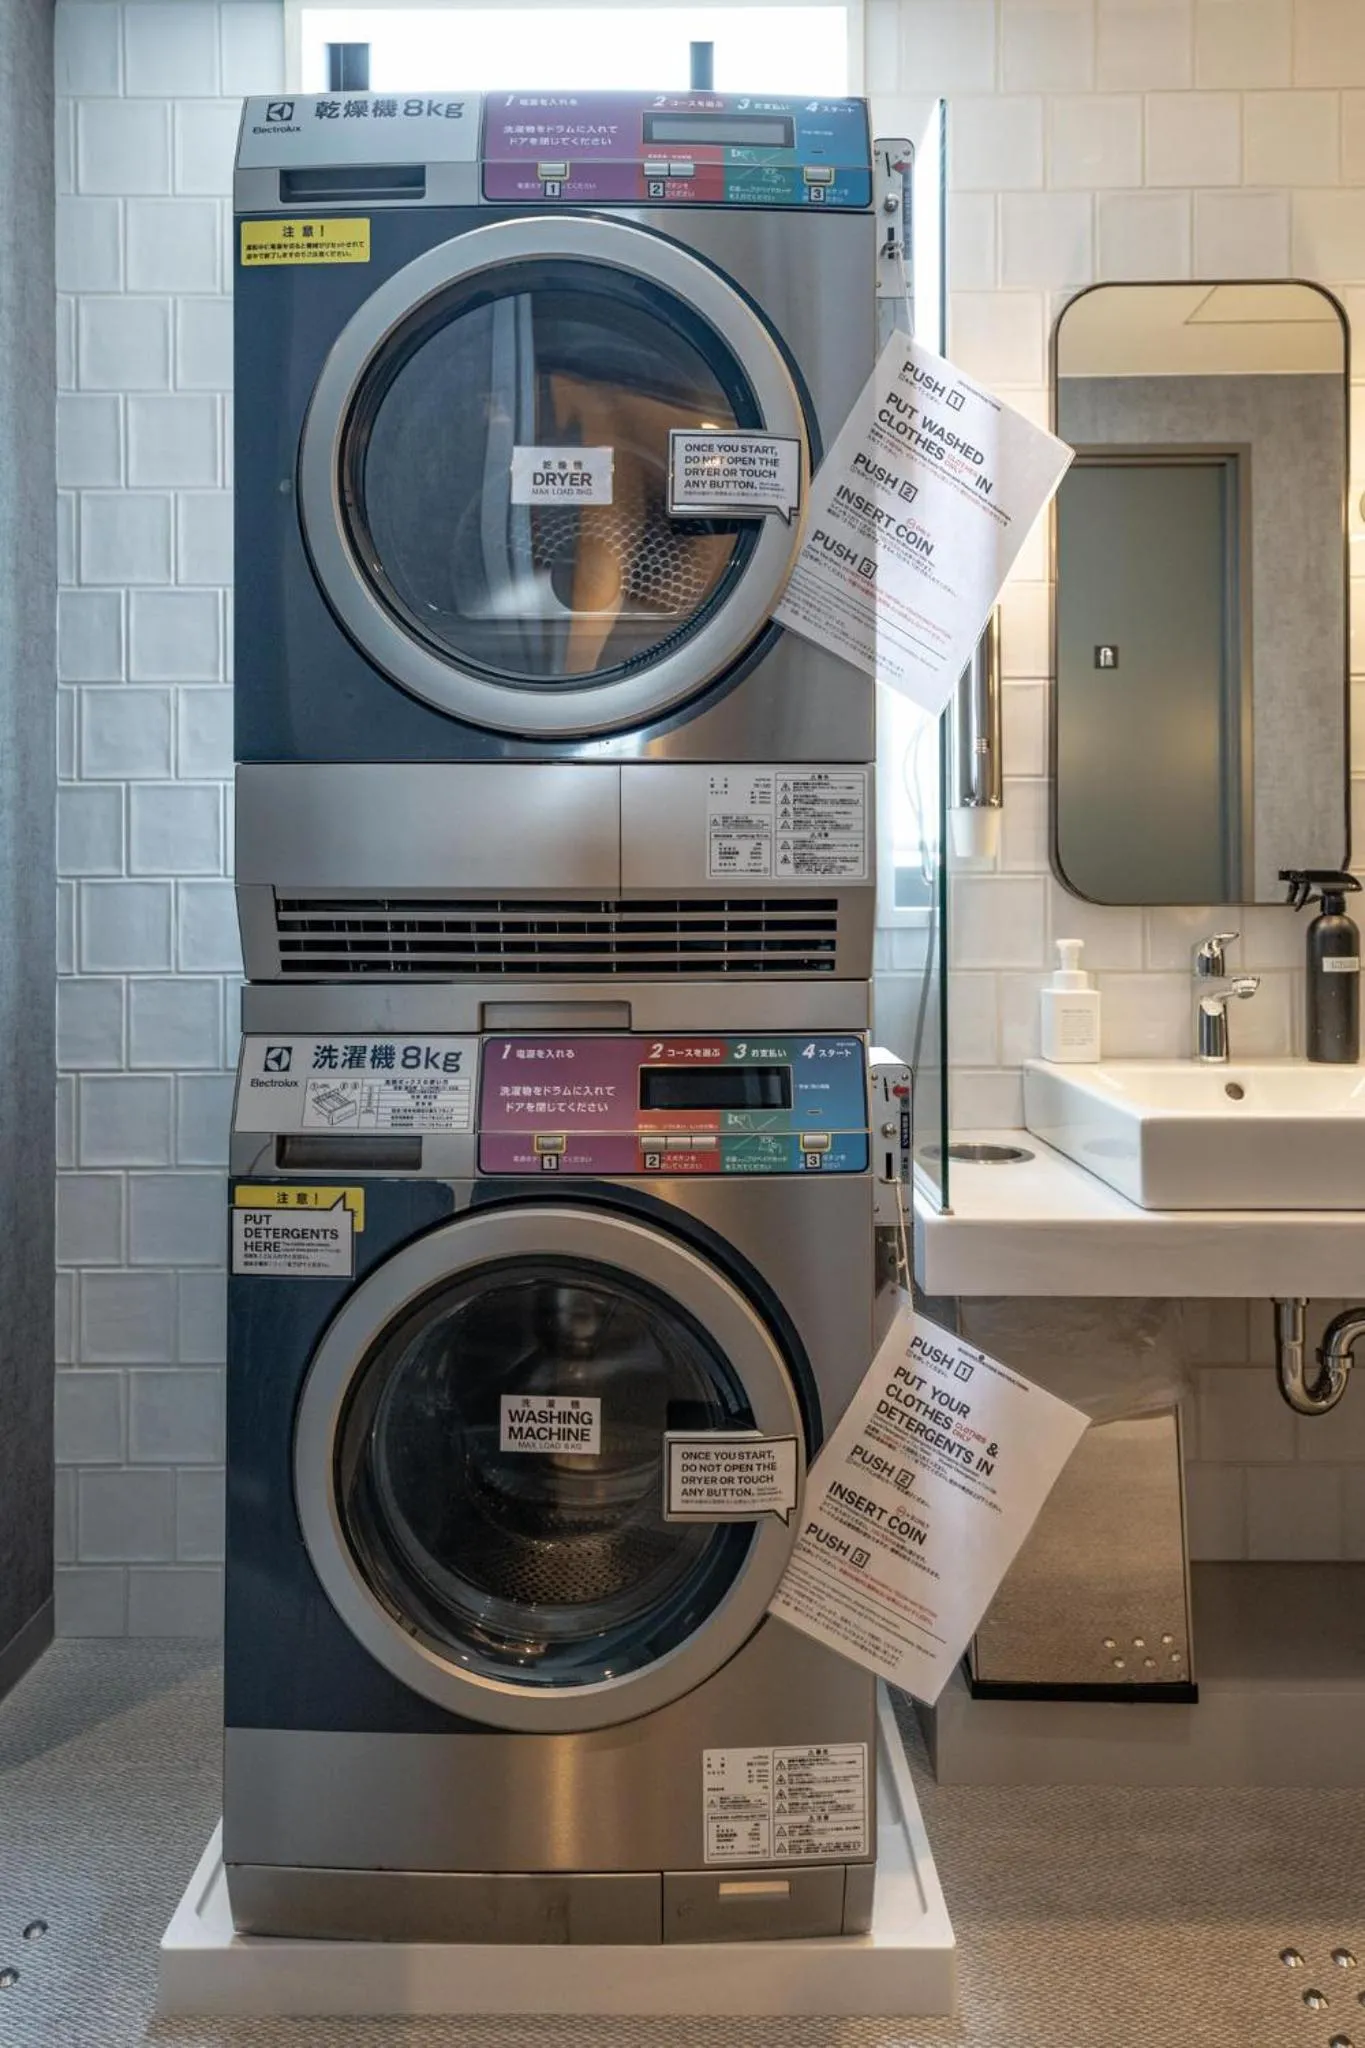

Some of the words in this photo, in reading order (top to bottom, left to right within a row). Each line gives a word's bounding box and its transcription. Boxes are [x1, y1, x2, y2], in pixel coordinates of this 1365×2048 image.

[653, 95, 666, 107] 2
[737, 98, 751, 110] 3
[806, 102, 818, 112] 4
[315, 99, 465, 119] 乾燥機8kg
[252, 125, 301, 134] Electrolux
[902, 361, 946, 398] PUSH
[885, 392, 918, 420] PUT
[921, 415, 985, 466] WASHED
[684, 443, 714, 452] ONCE
[715, 444, 739, 453] YOU
[741, 445, 778, 456] START,
[878, 408, 946, 461] CLOTHES
[974, 474, 994, 495] IN
[684, 455, 700, 464] DO
[702, 455, 725, 465] NOT
[726, 456, 756, 466] OPEN
[759, 457, 780, 467] THE
[684, 467, 721, 477] DRYER
[722, 468, 738, 477] OR
[740, 468, 777, 479] TOUCH
[853, 452, 899, 489] PUSH
[532, 472, 593, 486] DRYER
[684, 480, 708, 489] ANY
[709, 480, 758, 490] BUTTON.
[836, 484, 896, 528] INSERT
[895, 524, 935, 557] COIN
[811, 529, 859, 566] PUSH
[502, 1044, 512, 1059] 1
[516, 1049, 575, 1059] 電源を入れる
[650, 1043, 664, 1058] 2
[667, 1049, 720, 1058] コースを選ぶ
[734, 1043, 748, 1059] 3
[751, 1049, 787, 1058] お支払い
[802, 1043, 816, 1059] 4
[819, 1049, 852, 1058] スタート
[312, 1044, 462, 1073] 洗濯機8kg
[250, 1078, 299, 1088] Electrolux
[500, 1086, 616, 1097] 洗濯物をドラムに入れて
[505, 1102, 609, 1113] ドアを閉じてください
[243, 1214, 272, 1225] PUT
[243, 1227, 340, 1240] DETERGENTS
[243, 1241, 281, 1253] HERE
[910, 1336, 954, 1371] PUSH
[893, 1366, 927, 1392] PUT
[931, 1385, 971, 1419] YOUR
[508, 1409, 593, 1425] WASHING
[885, 1384, 954, 1431] CLOTHES
[985, 1442, 999, 1459] &
[508, 1426, 592, 1442] MACHINE
[876, 1399, 975, 1465] DETERGENTS
[975, 1458, 995, 1477] IN
[681, 1452, 711, 1460] ONCE
[714, 1452, 736, 1460] YOU
[738, 1450, 775, 1461] START,
[850, 1444, 896, 1478] PUSH
[681, 1464, 697, 1472] DO
[699, 1464, 722, 1472] NOT
[724, 1463, 753, 1472] OPEN
[756, 1462, 777, 1471] THE
[681, 1476, 717, 1484] DRYER
[720, 1475, 736, 1484] OR
[737, 1475, 774, 1484] TOUCH
[681, 1488, 705, 1496] ANY
[706, 1488, 755, 1496] BUTTON.
[828, 1480, 888, 1522] INSERT
[887, 1514, 928, 1547] COIN
[805, 1522, 851, 1556] PUSH
